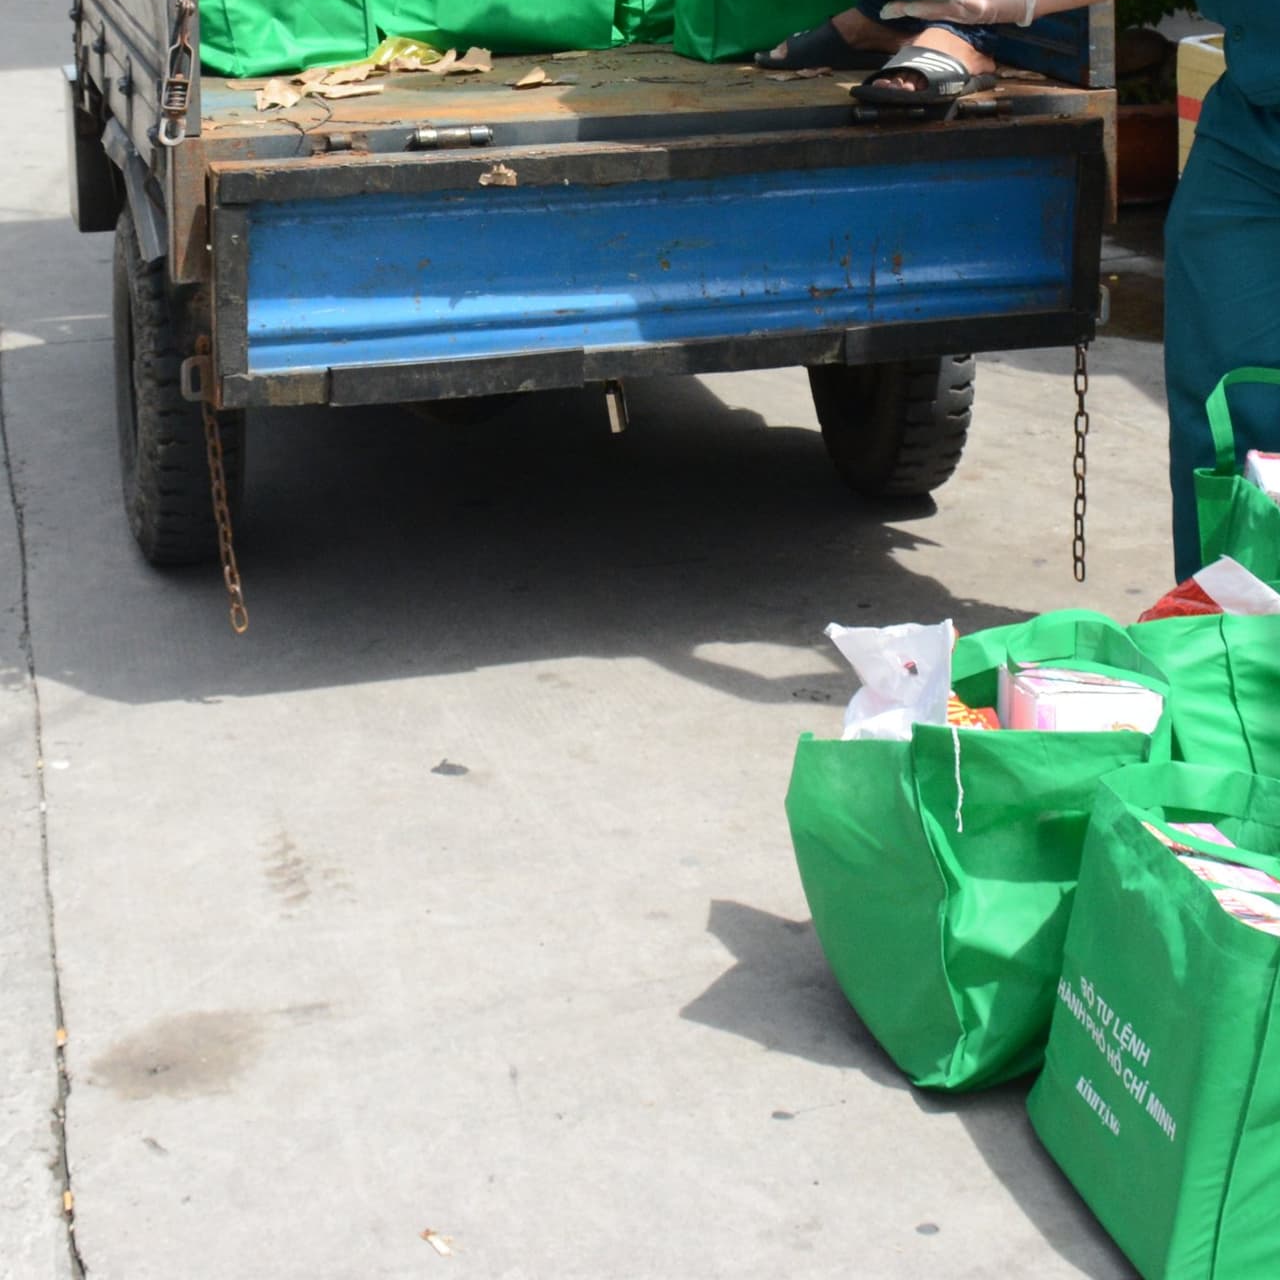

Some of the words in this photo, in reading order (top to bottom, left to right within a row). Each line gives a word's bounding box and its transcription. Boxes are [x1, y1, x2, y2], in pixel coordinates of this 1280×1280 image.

[1057, 975, 1086, 1025] HÀNH
[1086, 1013, 1105, 1054] PHỐ
[1106, 1043, 1122, 1076] HỒ
[1122, 1067, 1149, 1104] CHÍ
[1146, 1092, 1176, 1142] MINH
[1096, 995, 1114, 1027] TƯ
[1112, 1016, 1151, 1068] LỆNH
